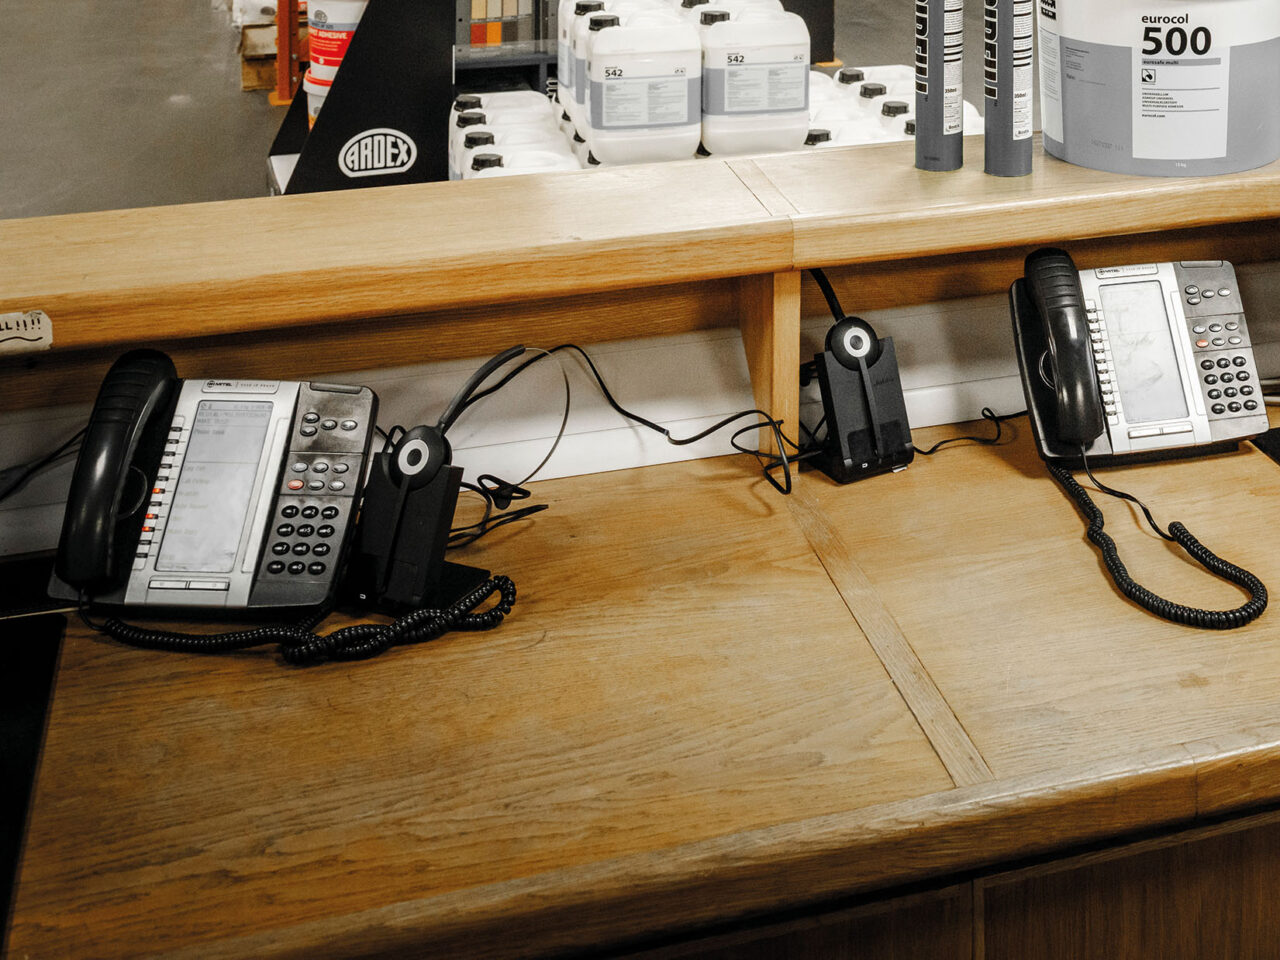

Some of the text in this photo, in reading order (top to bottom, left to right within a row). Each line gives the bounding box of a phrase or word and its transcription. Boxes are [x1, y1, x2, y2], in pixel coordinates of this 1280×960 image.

[1142, 13, 1189, 24] eurocol
[1142, 26, 1212, 56] 500
[727, 54, 745, 64] 542
[605, 68, 623, 78] 542
[346, 134, 409, 171] ARDEX
